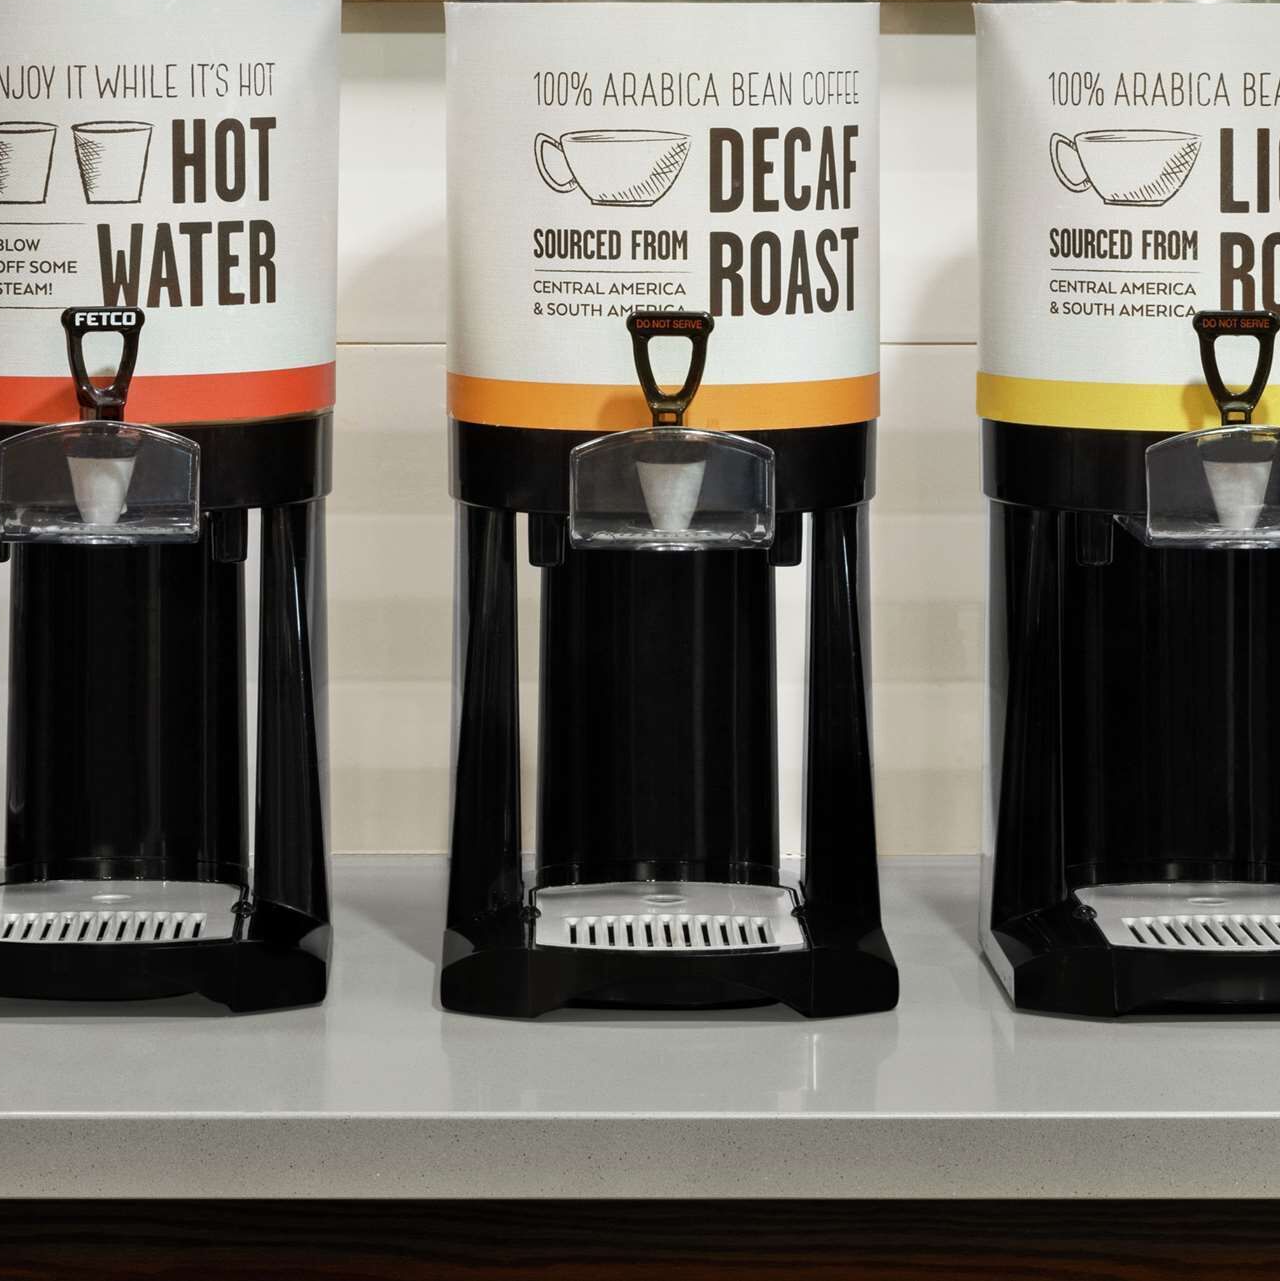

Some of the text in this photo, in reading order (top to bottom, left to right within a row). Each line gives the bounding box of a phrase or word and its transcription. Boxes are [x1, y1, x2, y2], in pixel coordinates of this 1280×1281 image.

[66, 64, 87, 100] IT
[94, 64, 178, 99] WHILE
[191, 62, 229, 98] IT'S
[239, 61, 276, 98] HOT
[533, 70, 860, 107] 100% ARABICA BEAN COFFEE
[1048, 71, 1106, 107] 100%
[1114, 71, 1231, 107] ARABICA
[172, 116, 277, 204] HOT
[709, 124, 859, 213] DECAF
[533, 228, 688, 261] SOURCED FROM
[1049, 227, 1198, 261] SOURCED FROM
[29, 260, 78, 275] SOME
[96, 220, 277, 308] WATER
[709, 226, 859, 317] ROAST
[533, 280, 687, 296] CENTRAL AMERICA
[1049, 279, 1197, 297] CENTRAL AMERICA
[74, 311, 137, 327] FETCO
[533, 302, 543, 316] &
[546, 302, 602, 317] SOUTH
[636, 319, 703, 329] DO NOT SERVE
[1049, 301, 1197, 318] & SOUTH AMERICA
[1202, 319, 1270, 329] DO NOT SERVE
